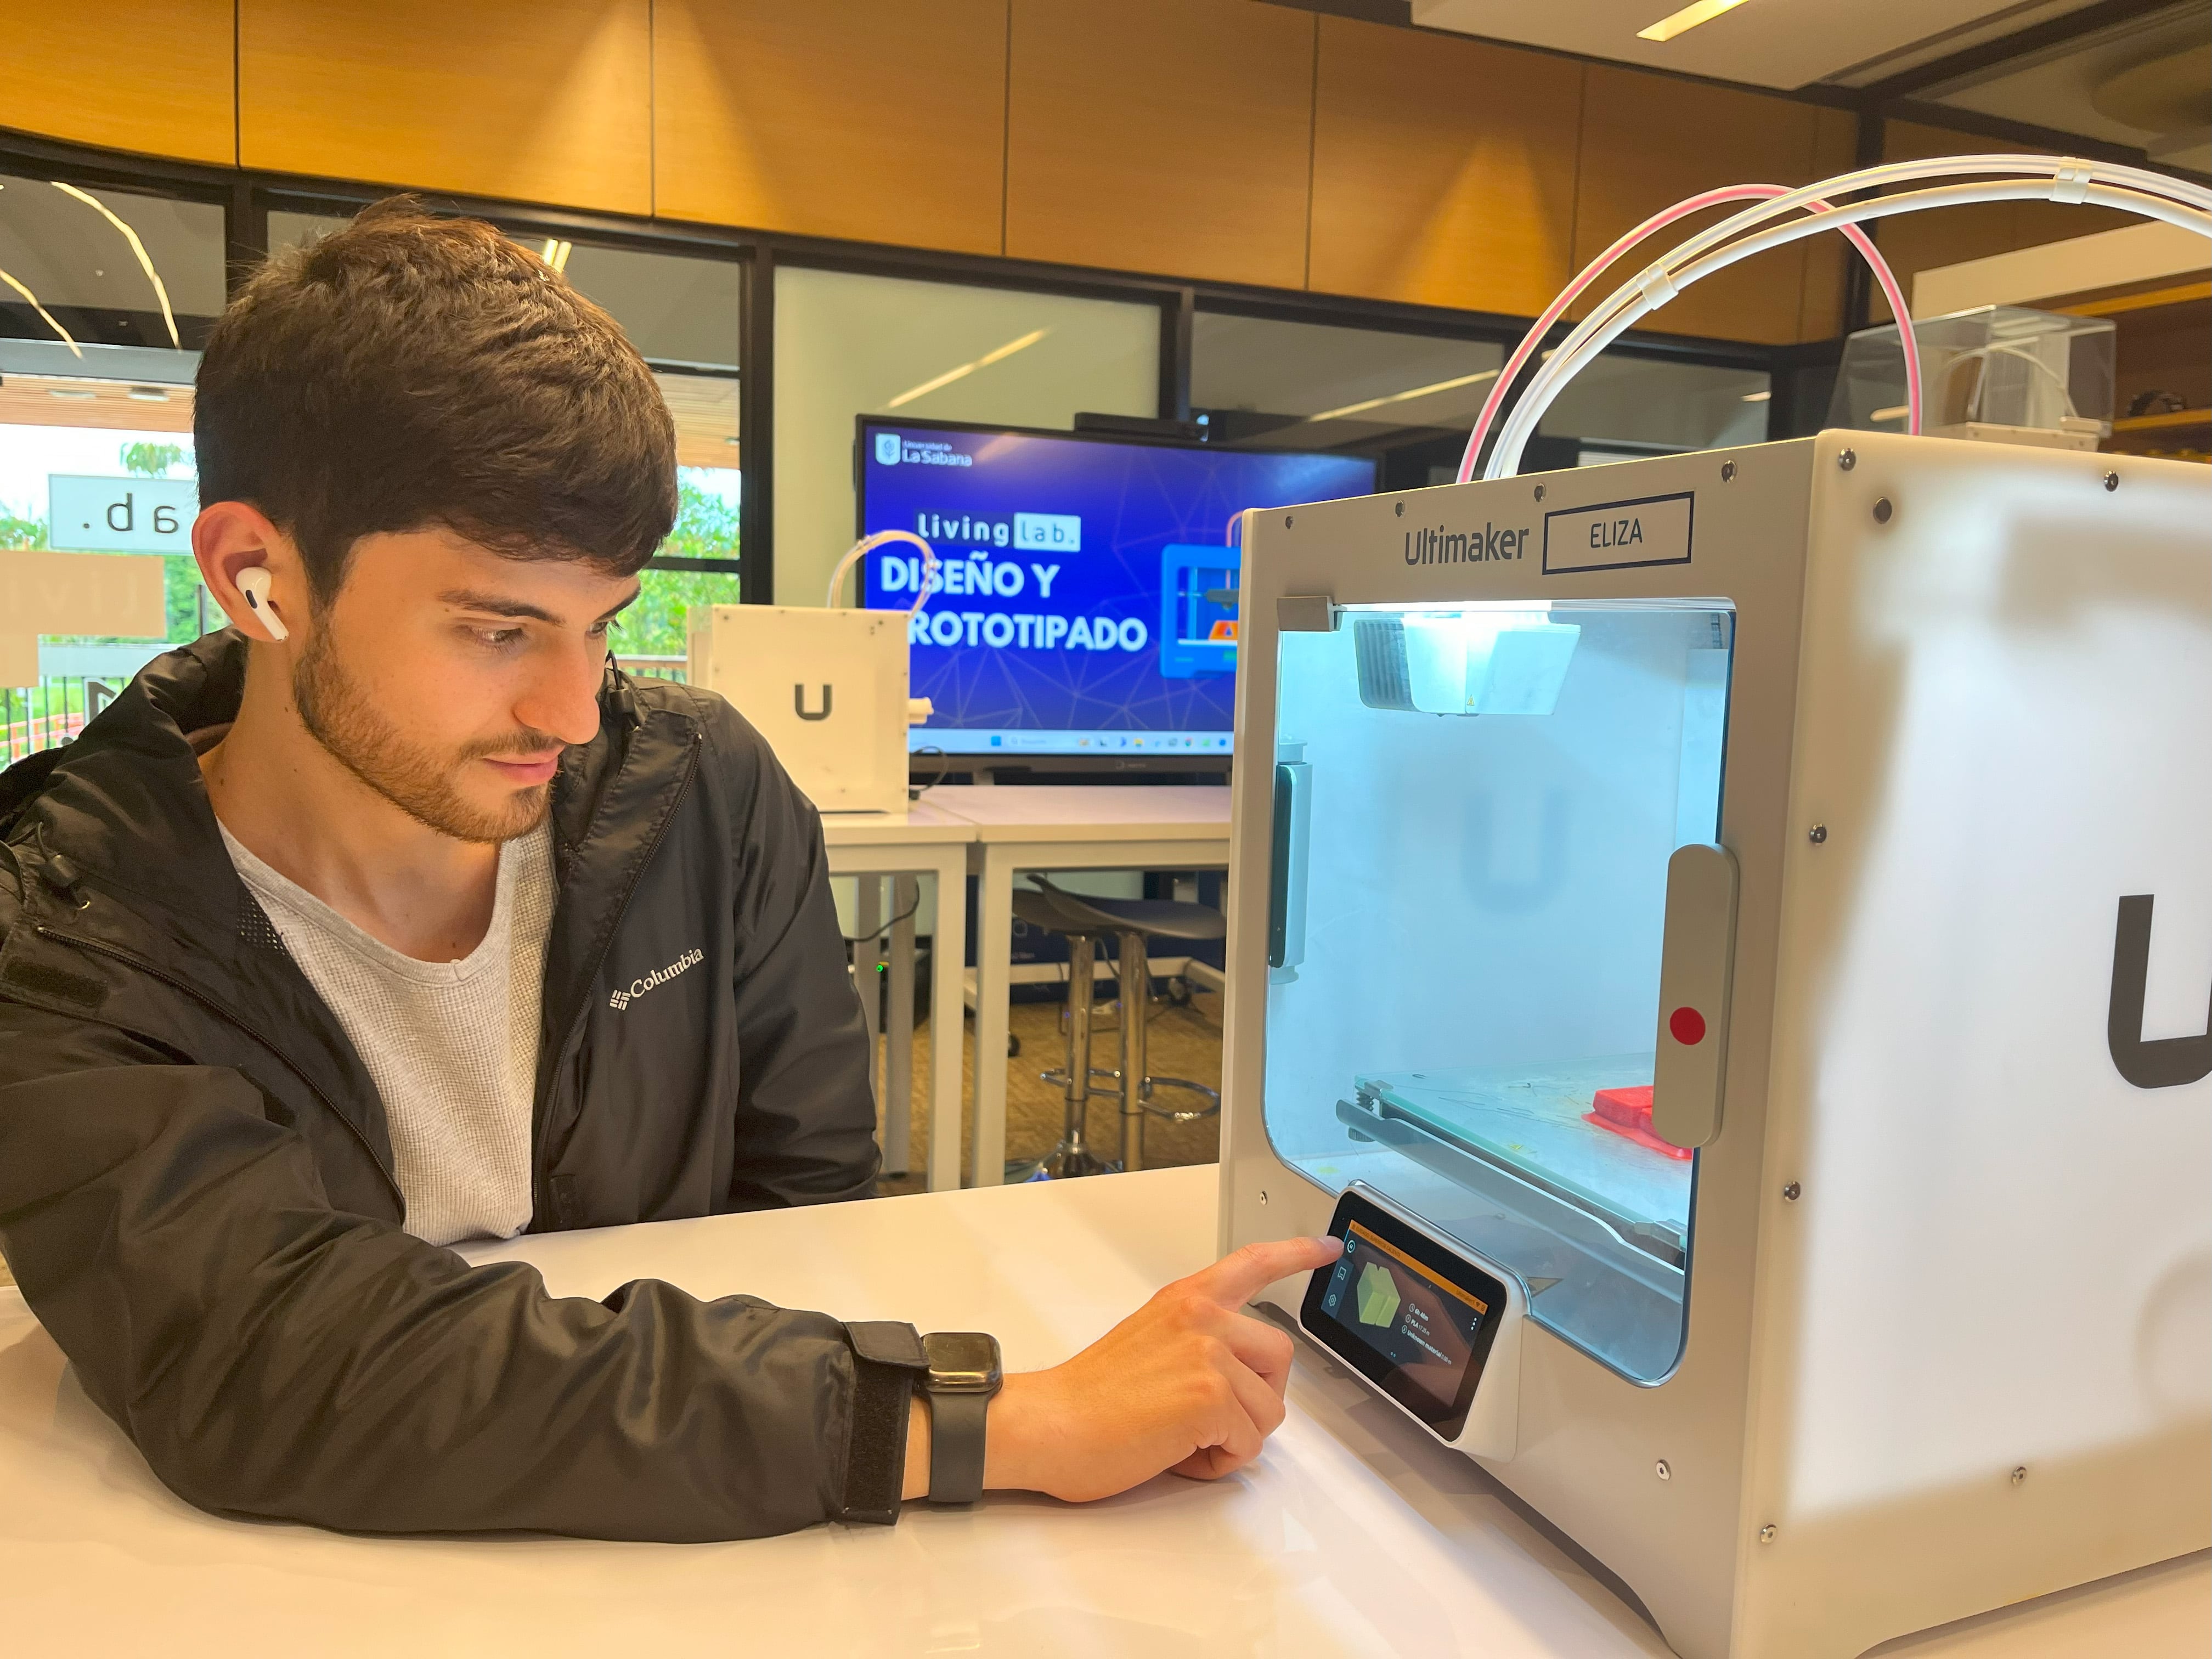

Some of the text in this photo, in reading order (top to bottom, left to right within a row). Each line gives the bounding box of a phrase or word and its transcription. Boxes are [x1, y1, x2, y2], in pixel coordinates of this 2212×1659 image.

[918, 512, 1075, 547] living lab.
[1404, 517, 1643, 566] Ultimaker ELIZA
[881, 550, 1060, 599] DISEÑO Y
[908, 610, 1148, 652] ROTOTIPADO
[794, 684, 832, 721] U
[630, 948, 704, 998] Columbia
[2107, 894, 2212, 1089] U
[1407, 1329, 1425, 1346] Unknown
[1425, 1342, 1442, 1358] material
[1410, 1318, 1419, 1328] PLA
